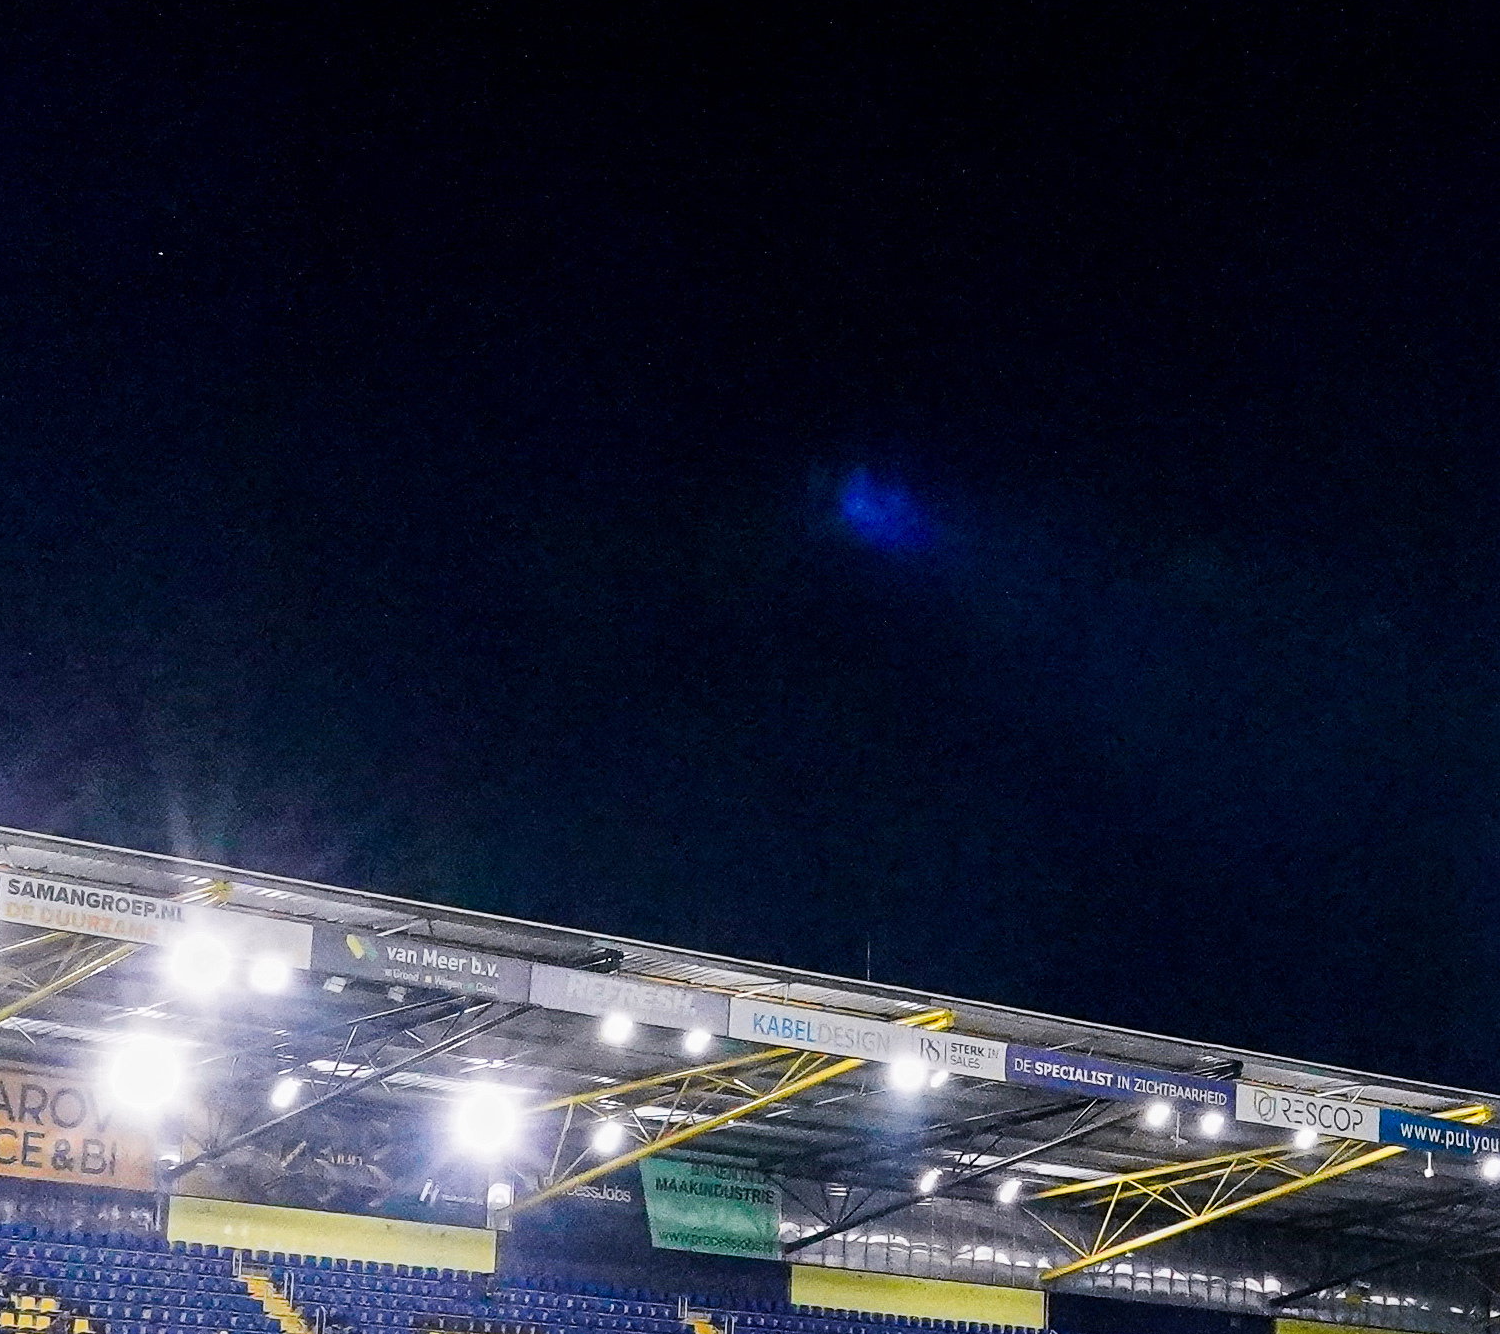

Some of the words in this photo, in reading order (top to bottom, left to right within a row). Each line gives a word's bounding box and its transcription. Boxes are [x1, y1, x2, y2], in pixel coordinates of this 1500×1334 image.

[7, 877, 186, 924] SAMANGROEP.NL
[385, 944, 418, 964] van
[421, 947, 466, 973] Meer
[470, 958, 500, 978] b.v.
[950, 1042, 985, 1059] STERK
[1014, 1057, 1031, 1073] DE
[1034, 1061, 1113, 1088] SPECIALIST
[1117, 1075, 1131, 1090] IN
[1133, 1077, 1227, 1107] ZICHTBAARHEID
[1281, 1095, 1364, 1133] RESCOP
[654, 1177, 775, 1205] MAAKINDUSTRIE
